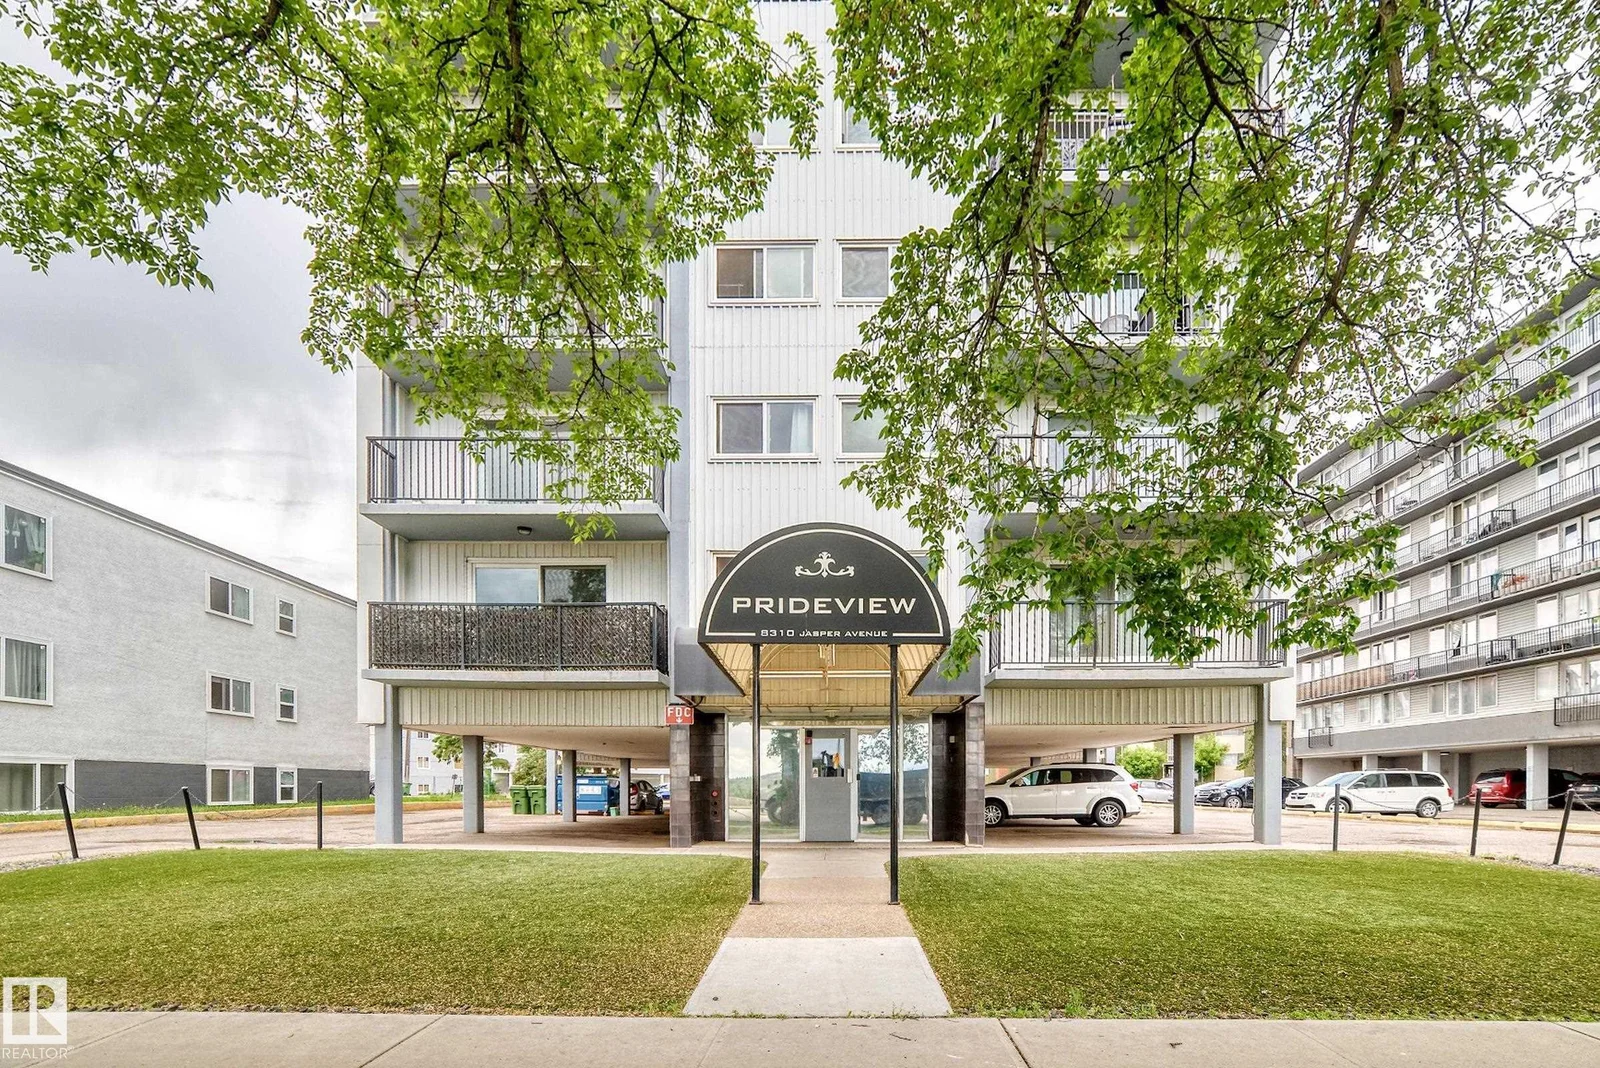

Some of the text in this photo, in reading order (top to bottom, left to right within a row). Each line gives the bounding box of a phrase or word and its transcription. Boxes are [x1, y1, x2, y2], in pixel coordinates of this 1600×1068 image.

[732, 597, 917, 614] PRIDEVIEW
[760, 629, 795, 637] 8310
[799, 629, 841, 637] JASPER
[667, 707, 691, 718] FDC
